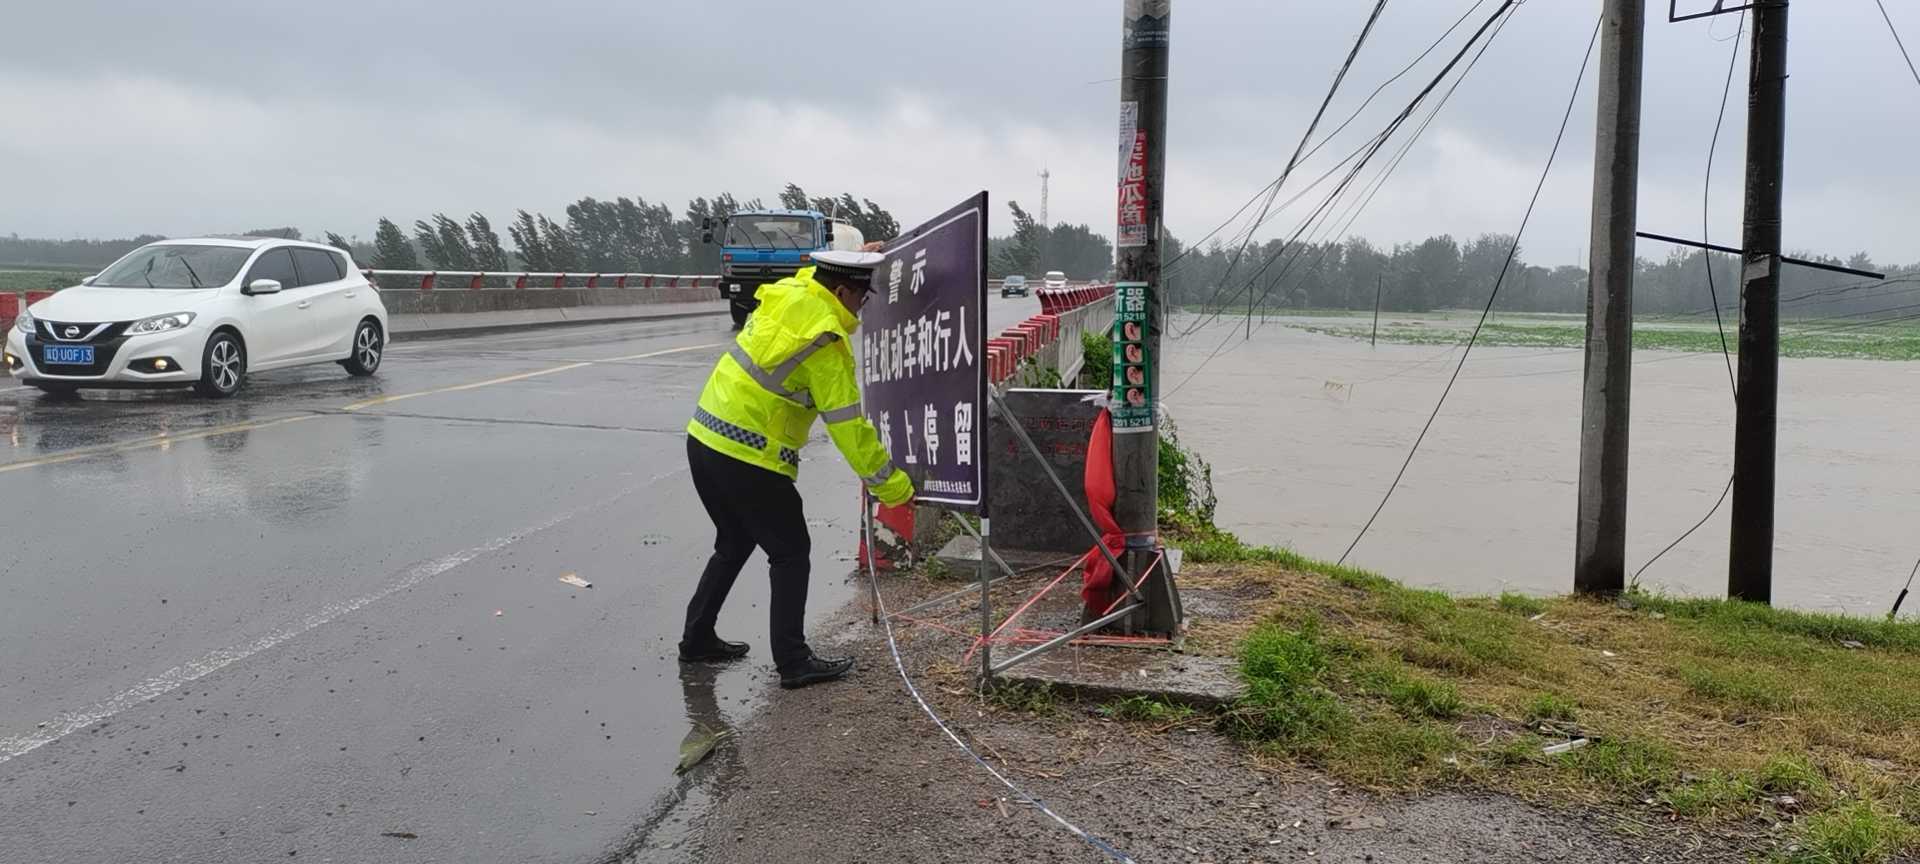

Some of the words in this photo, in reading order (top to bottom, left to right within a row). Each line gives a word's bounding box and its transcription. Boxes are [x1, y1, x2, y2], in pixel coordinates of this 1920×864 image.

[888, 248, 927, 305] 警示
[1124, 312, 1146, 321] 5218
[863, 306, 973, 387] 禁止机动车和行人
[866, 401, 973, 466] 桥上停留
[1005, 416, 1097, 432] 卫南运河
[1129, 417, 1151, 427] 5218
